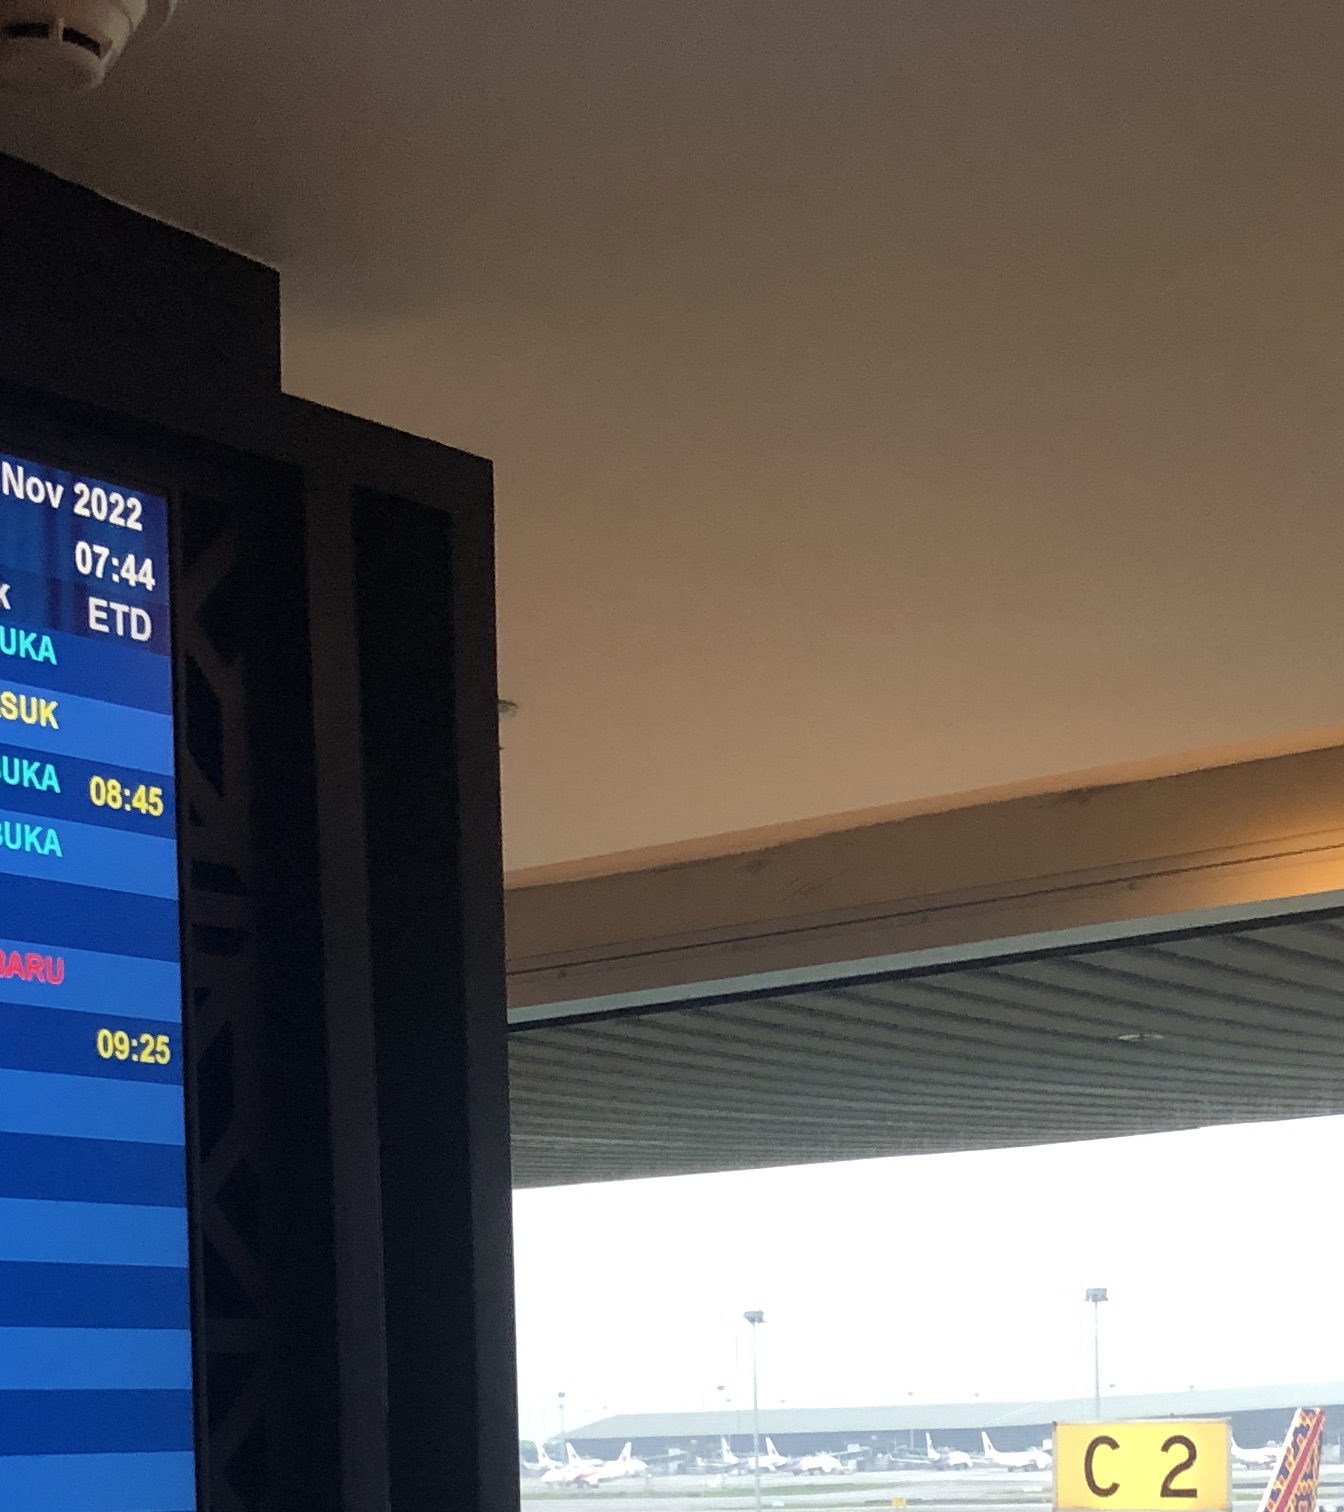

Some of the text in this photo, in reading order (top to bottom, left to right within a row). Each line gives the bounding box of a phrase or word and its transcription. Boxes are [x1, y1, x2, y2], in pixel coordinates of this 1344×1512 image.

[1, 461, 64, 509] Nov
[73, 482, 143, 531] 2022
[75, 540, 156, 591] 07:44
[88, 596, 152, 641] ETD
[89, 775, 164, 816] 08:45
[97, 1028, 170, 1065] 09:25
[1083, 1434, 1199, 1499] C 2
